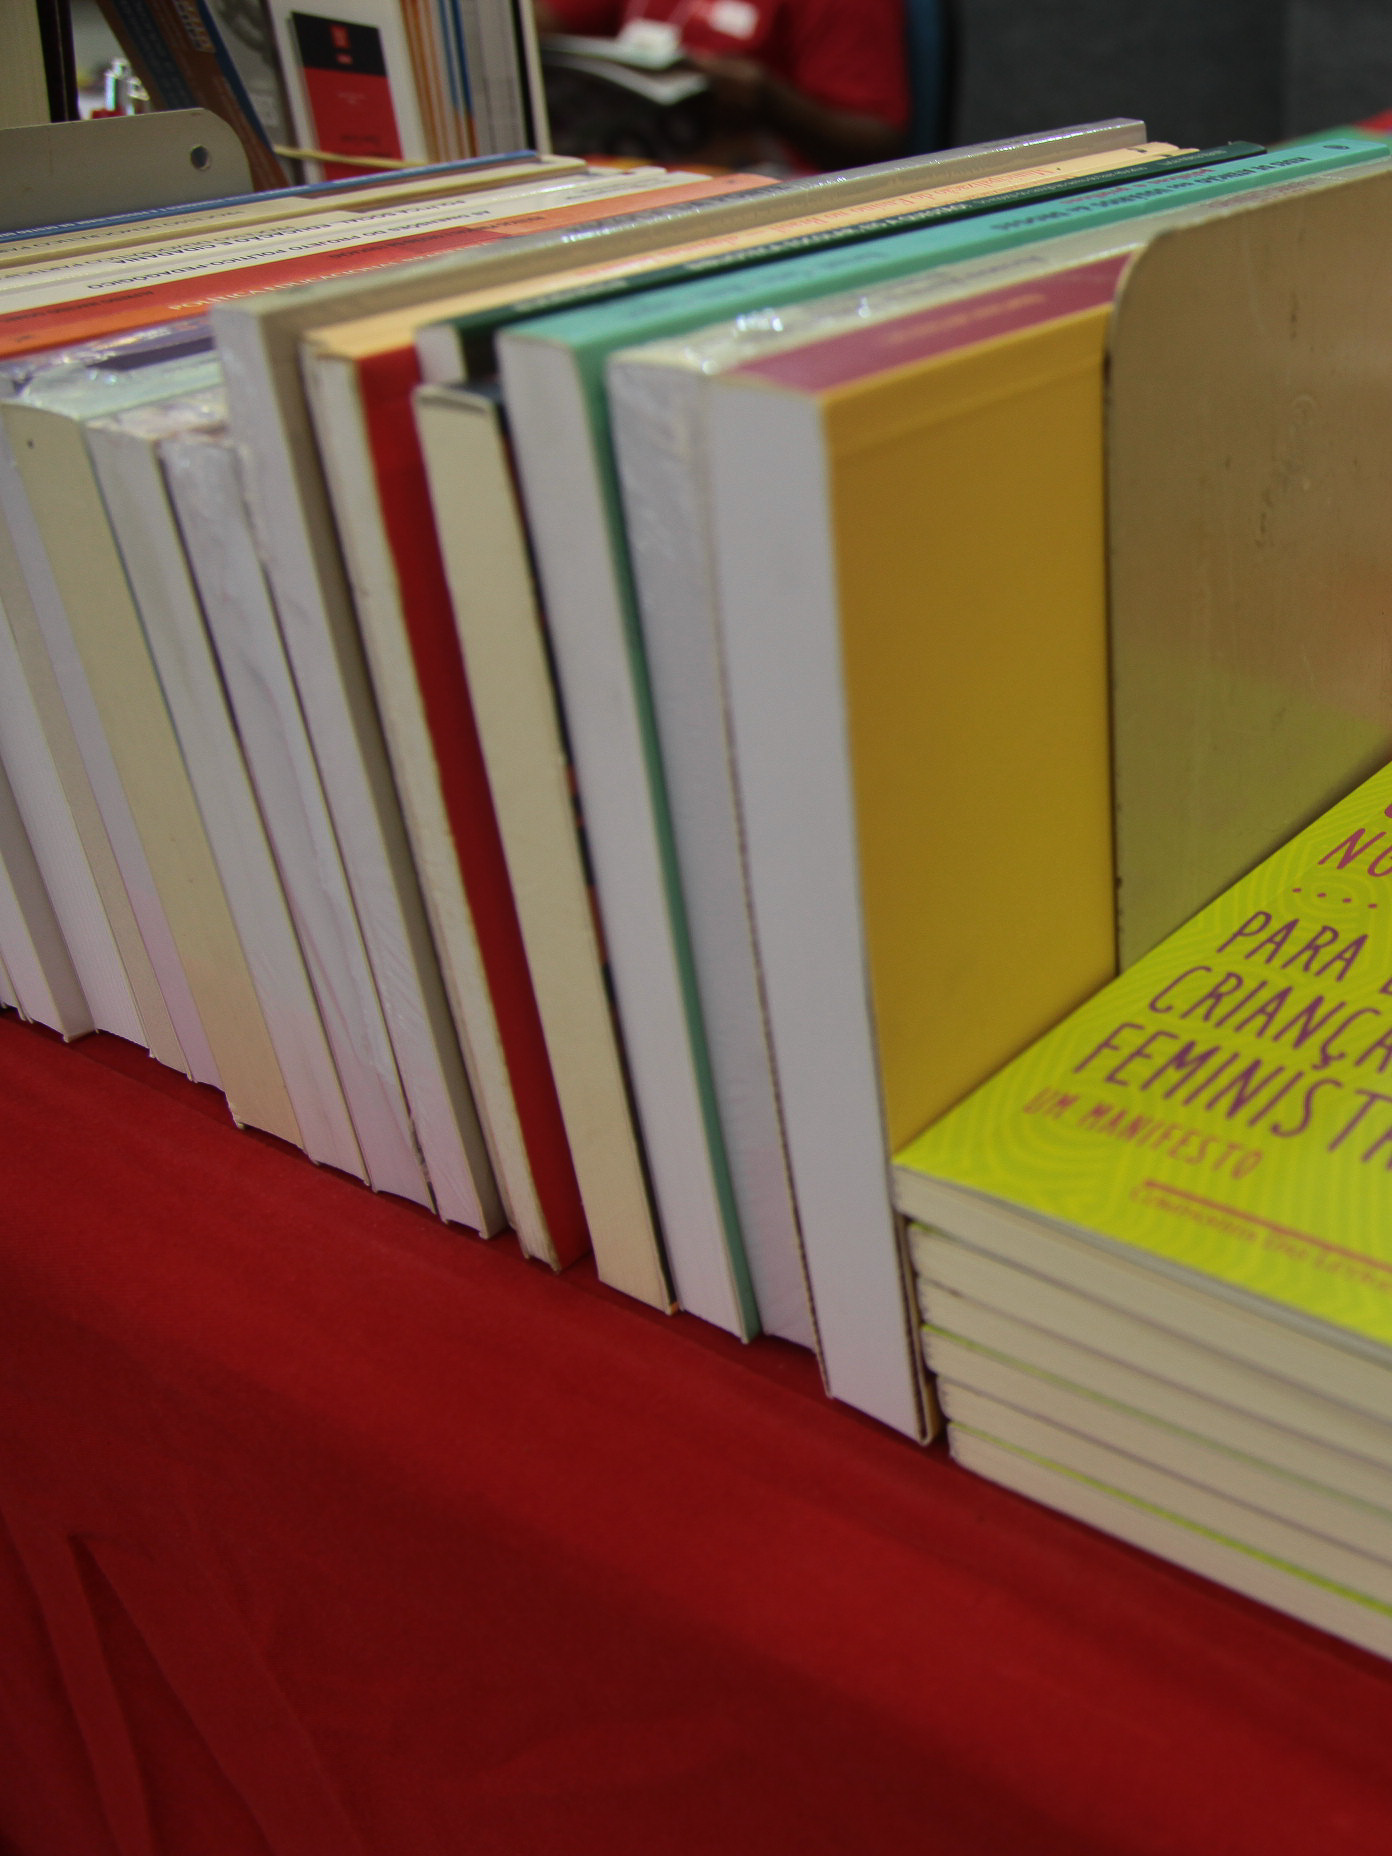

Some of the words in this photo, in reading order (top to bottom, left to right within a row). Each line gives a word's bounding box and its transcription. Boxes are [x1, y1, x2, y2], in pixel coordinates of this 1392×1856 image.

[1216, 911, 1369, 982] PARA
[1023, 1087, 1078, 1116] UM
[1078, 1099, 1264, 1181] MANIFESTO
